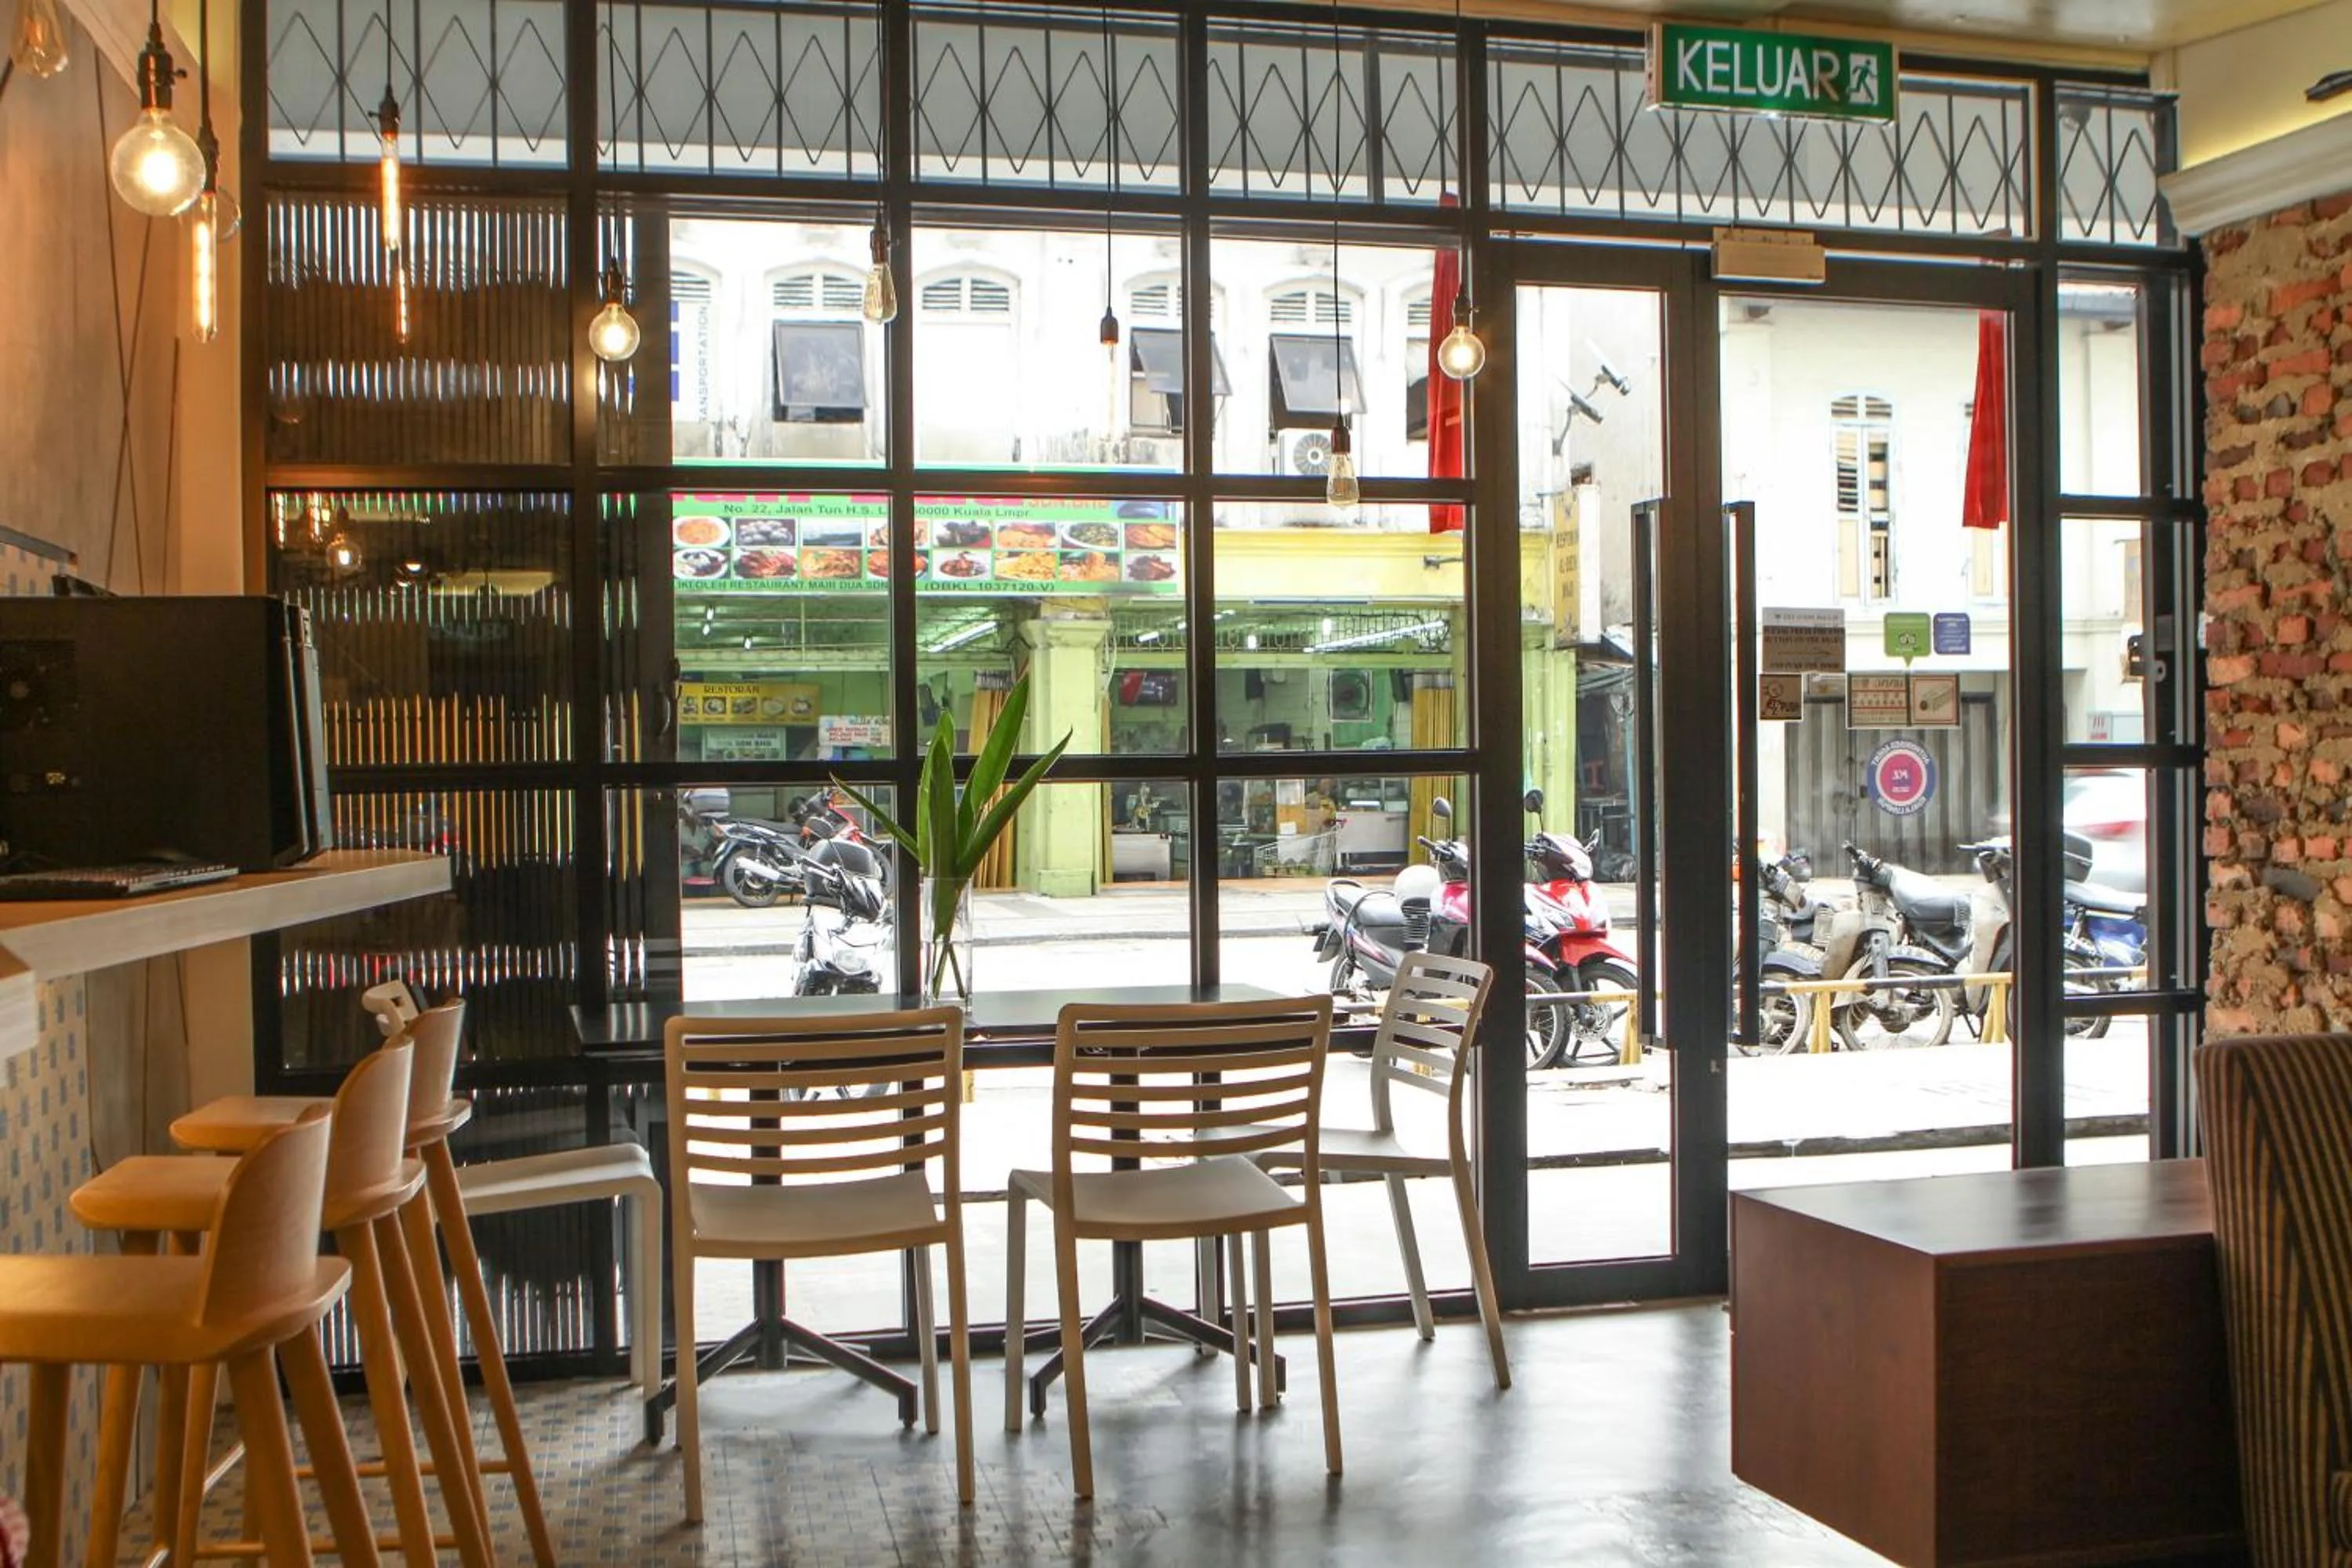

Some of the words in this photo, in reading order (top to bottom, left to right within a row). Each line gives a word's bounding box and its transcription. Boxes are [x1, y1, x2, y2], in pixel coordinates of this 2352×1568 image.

[1677, 38, 1841, 102] KELUAR
[775, 504, 813, 514] Jalan
[817, 505, 841, 514] Tun
[954, 507, 991, 517] Kuala
